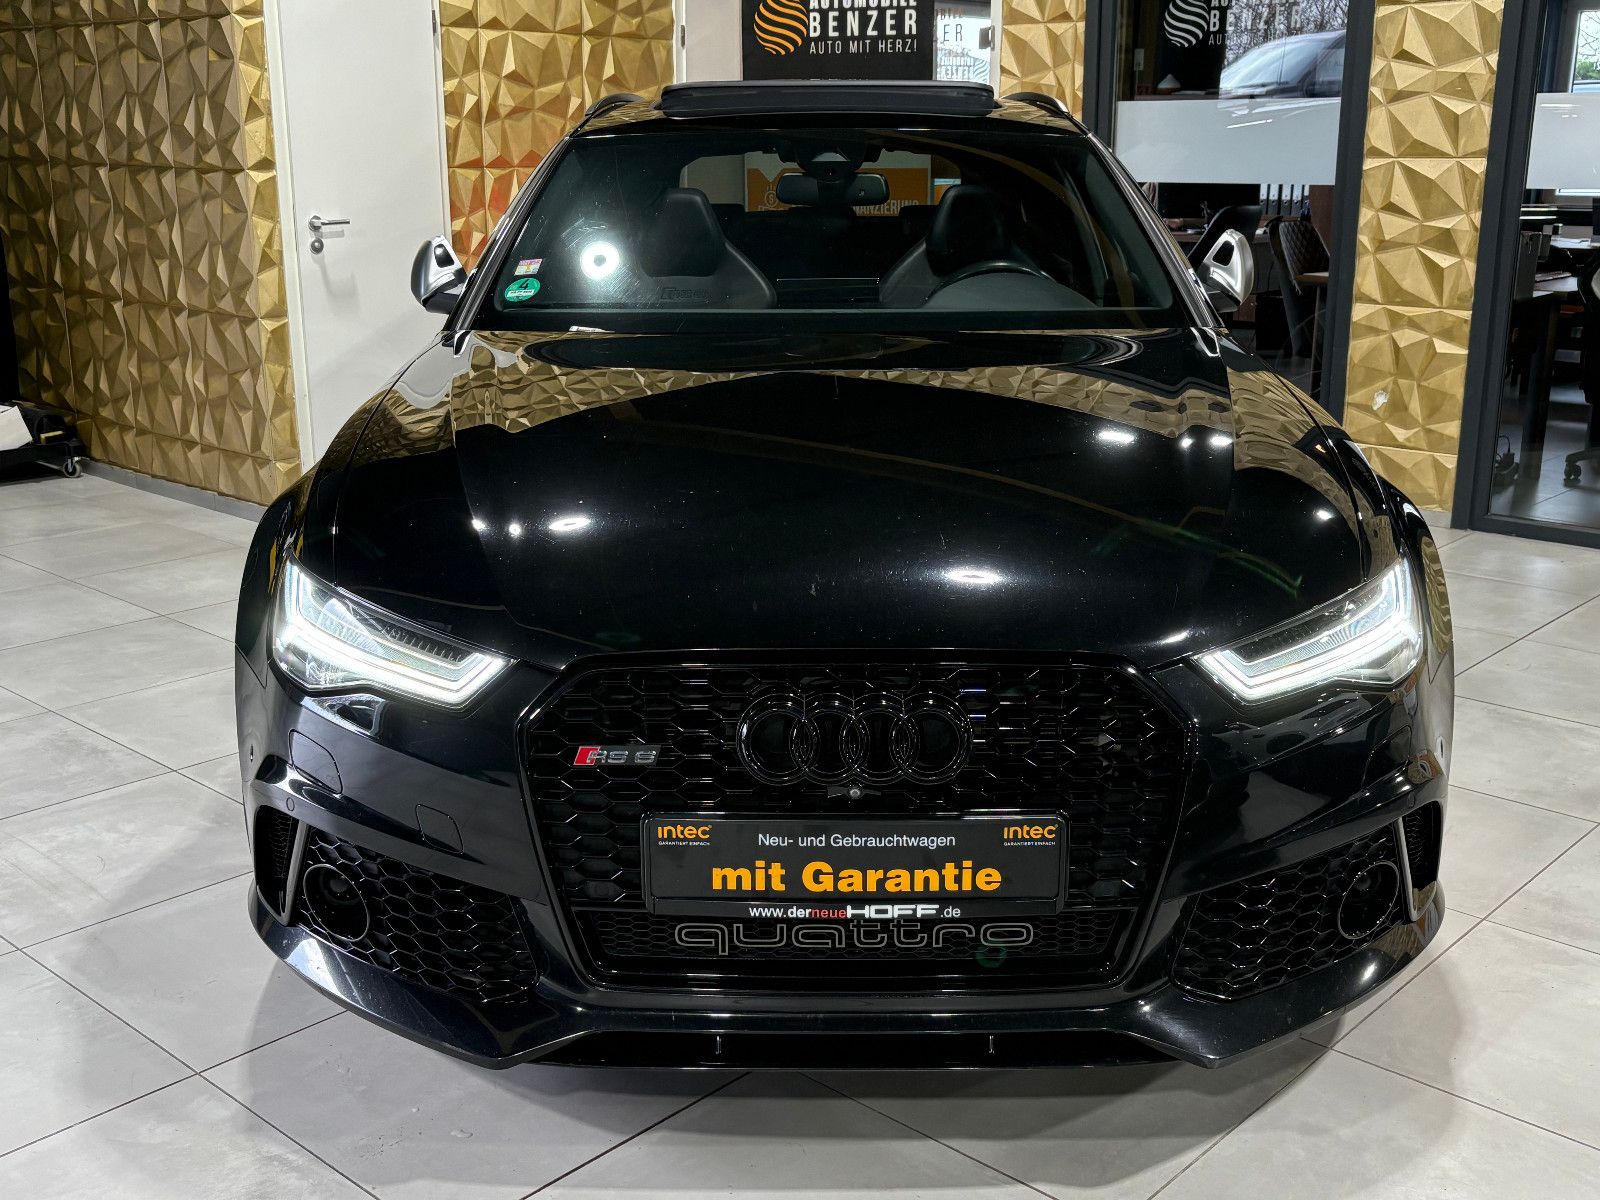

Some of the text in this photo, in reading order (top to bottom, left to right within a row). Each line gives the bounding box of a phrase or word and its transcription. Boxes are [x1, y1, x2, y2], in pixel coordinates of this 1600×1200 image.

[810, 9, 917, 37] BENZER
[810, 38, 917, 54] AUTO MIT HERZ!
[519, 279, 530, 290] 4
[658, 824, 710, 839] intec
[1003, 824, 1056, 839] intec
[758, 833, 956, 850] Neu- und Gebrauchtwagen
[712, 860, 1002, 893] mit Garantie
[674, 919, 1034, 956] quattro
